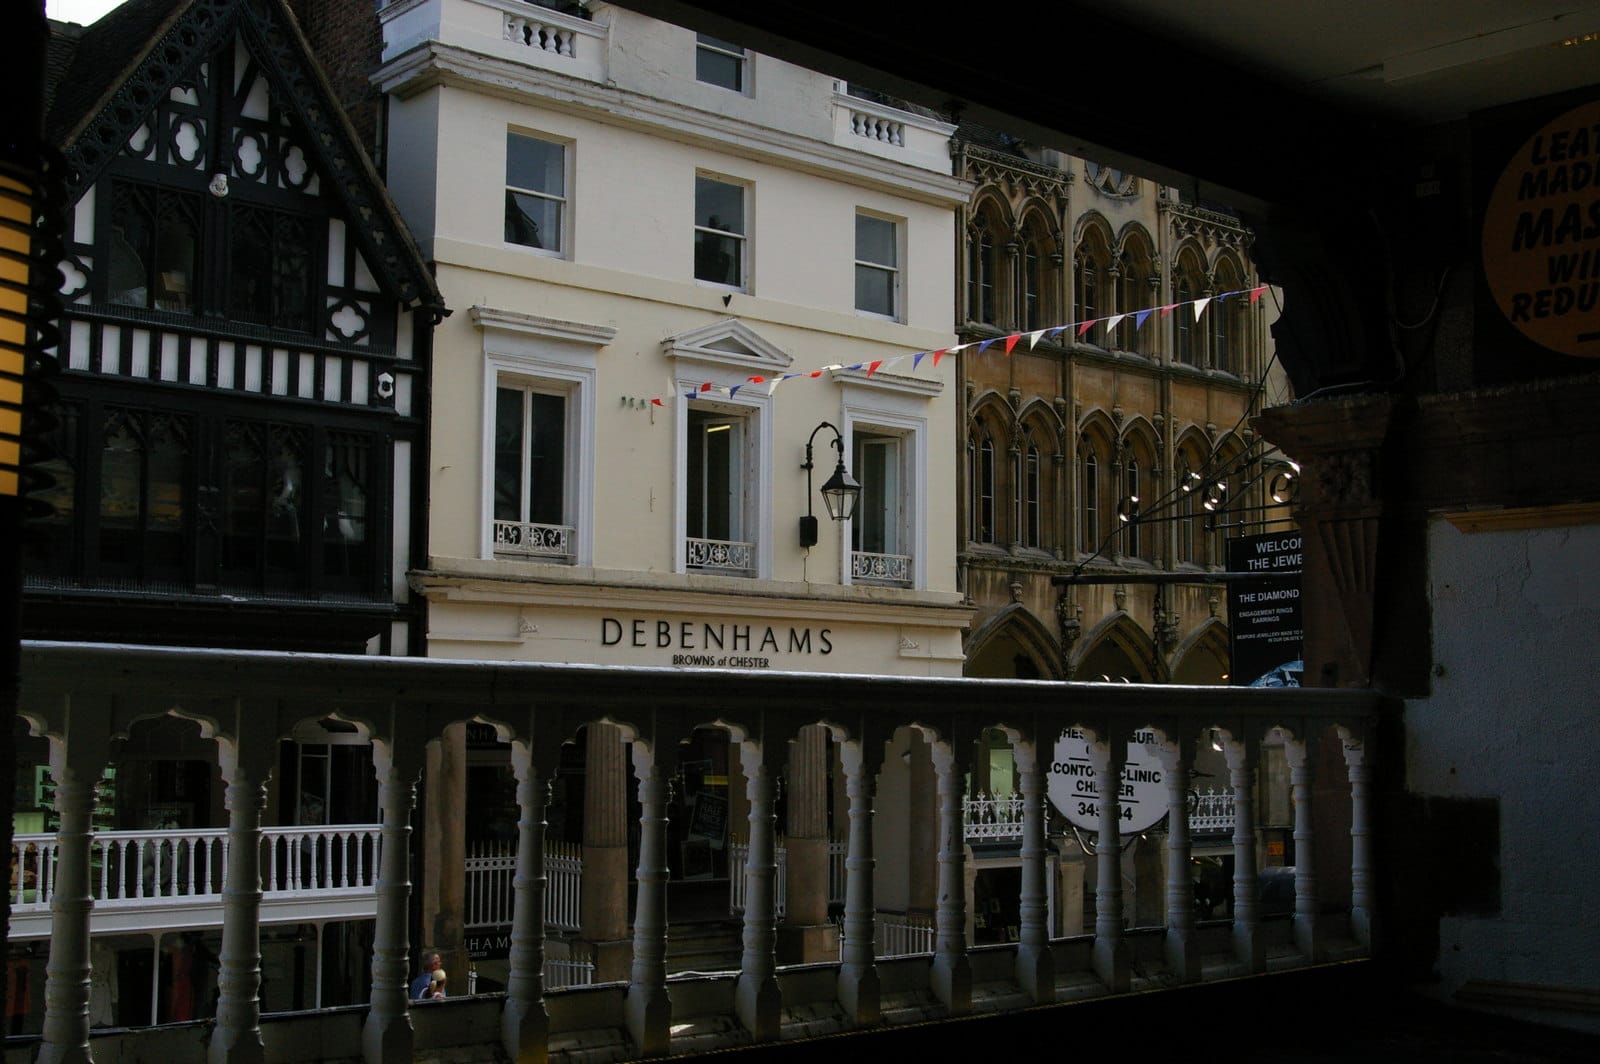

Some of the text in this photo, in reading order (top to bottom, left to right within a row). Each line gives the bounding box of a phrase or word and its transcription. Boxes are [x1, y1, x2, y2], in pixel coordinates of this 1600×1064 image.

[1248, 559, 1270, 570] THE
[1239, 588, 1299, 603] THE DIAMOND
[1239, 608, 1275, 618] ENGAGEMENT
[602, 618, 832, 654] DEBENHAMS
[673, 655, 770, 668] BROWNS of CHESTER
[1076, 780, 1134, 797] CHER
